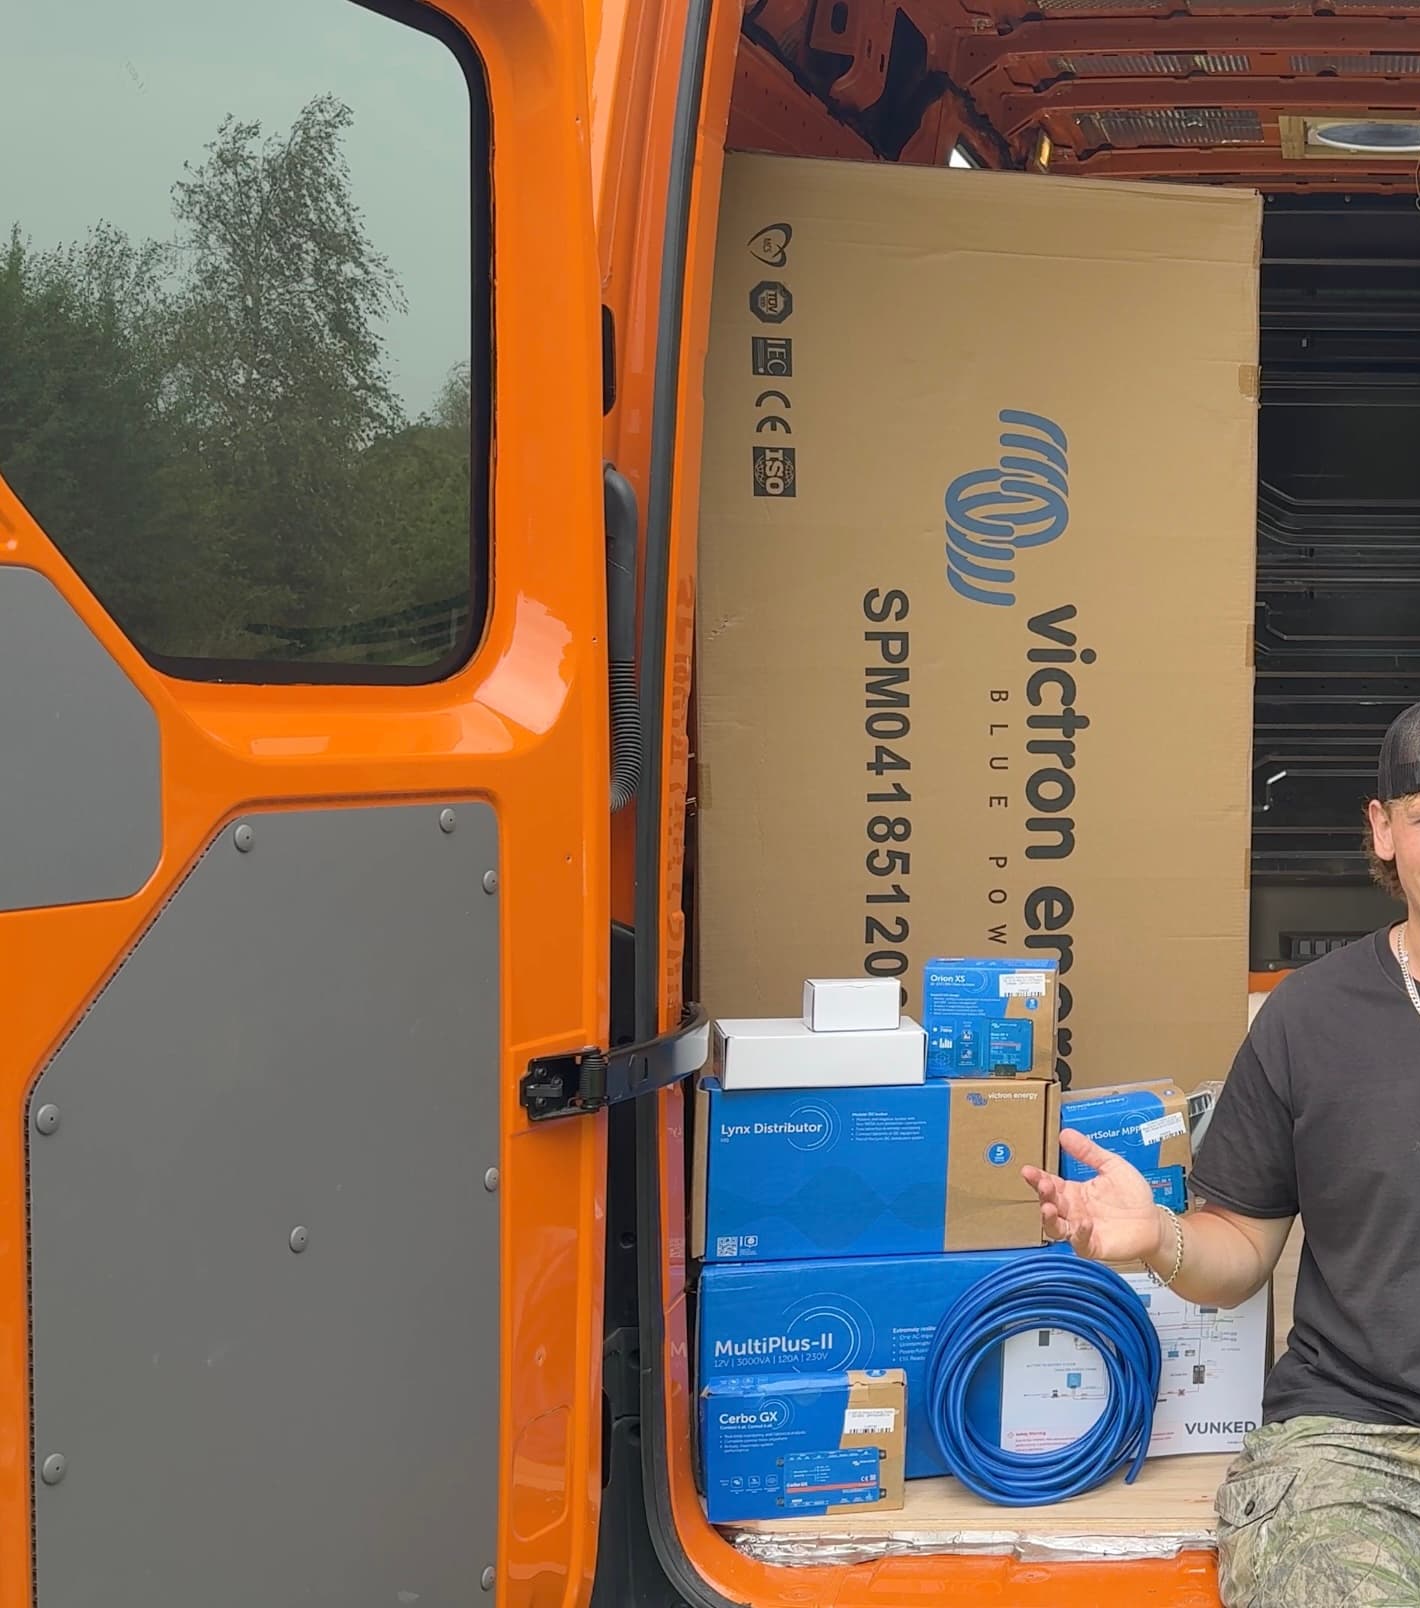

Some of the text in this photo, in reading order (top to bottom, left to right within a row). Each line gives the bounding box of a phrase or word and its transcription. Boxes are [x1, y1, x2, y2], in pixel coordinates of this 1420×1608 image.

[767, 339, 787, 375] IEC
[755, 390, 792, 434] CE
[764, 449, 785, 495] ISO
[1025, 604, 1097, 860] victron
[863, 587, 912, 1008] SPM04185120
[987, 689, 1009, 945] BLUE POW
[930, 974, 966, 983] Orion XS
[1013, 1092, 1038, 1100] energy
[721, 1121, 823, 1137] Lynx Distributor
[1086, 1125, 1142, 1141] artSolar MPP
[995, 1145, 1005, 1156] 5
[714, 1332, 833, 1357] MultiPlus-II
[714, 1352, 829, 1368] 12V 3000VA 120A 230V
[719, 1411, 778, 1424] Cerbo GX
[1185, 1421, 1257, 1435] VUNKED
